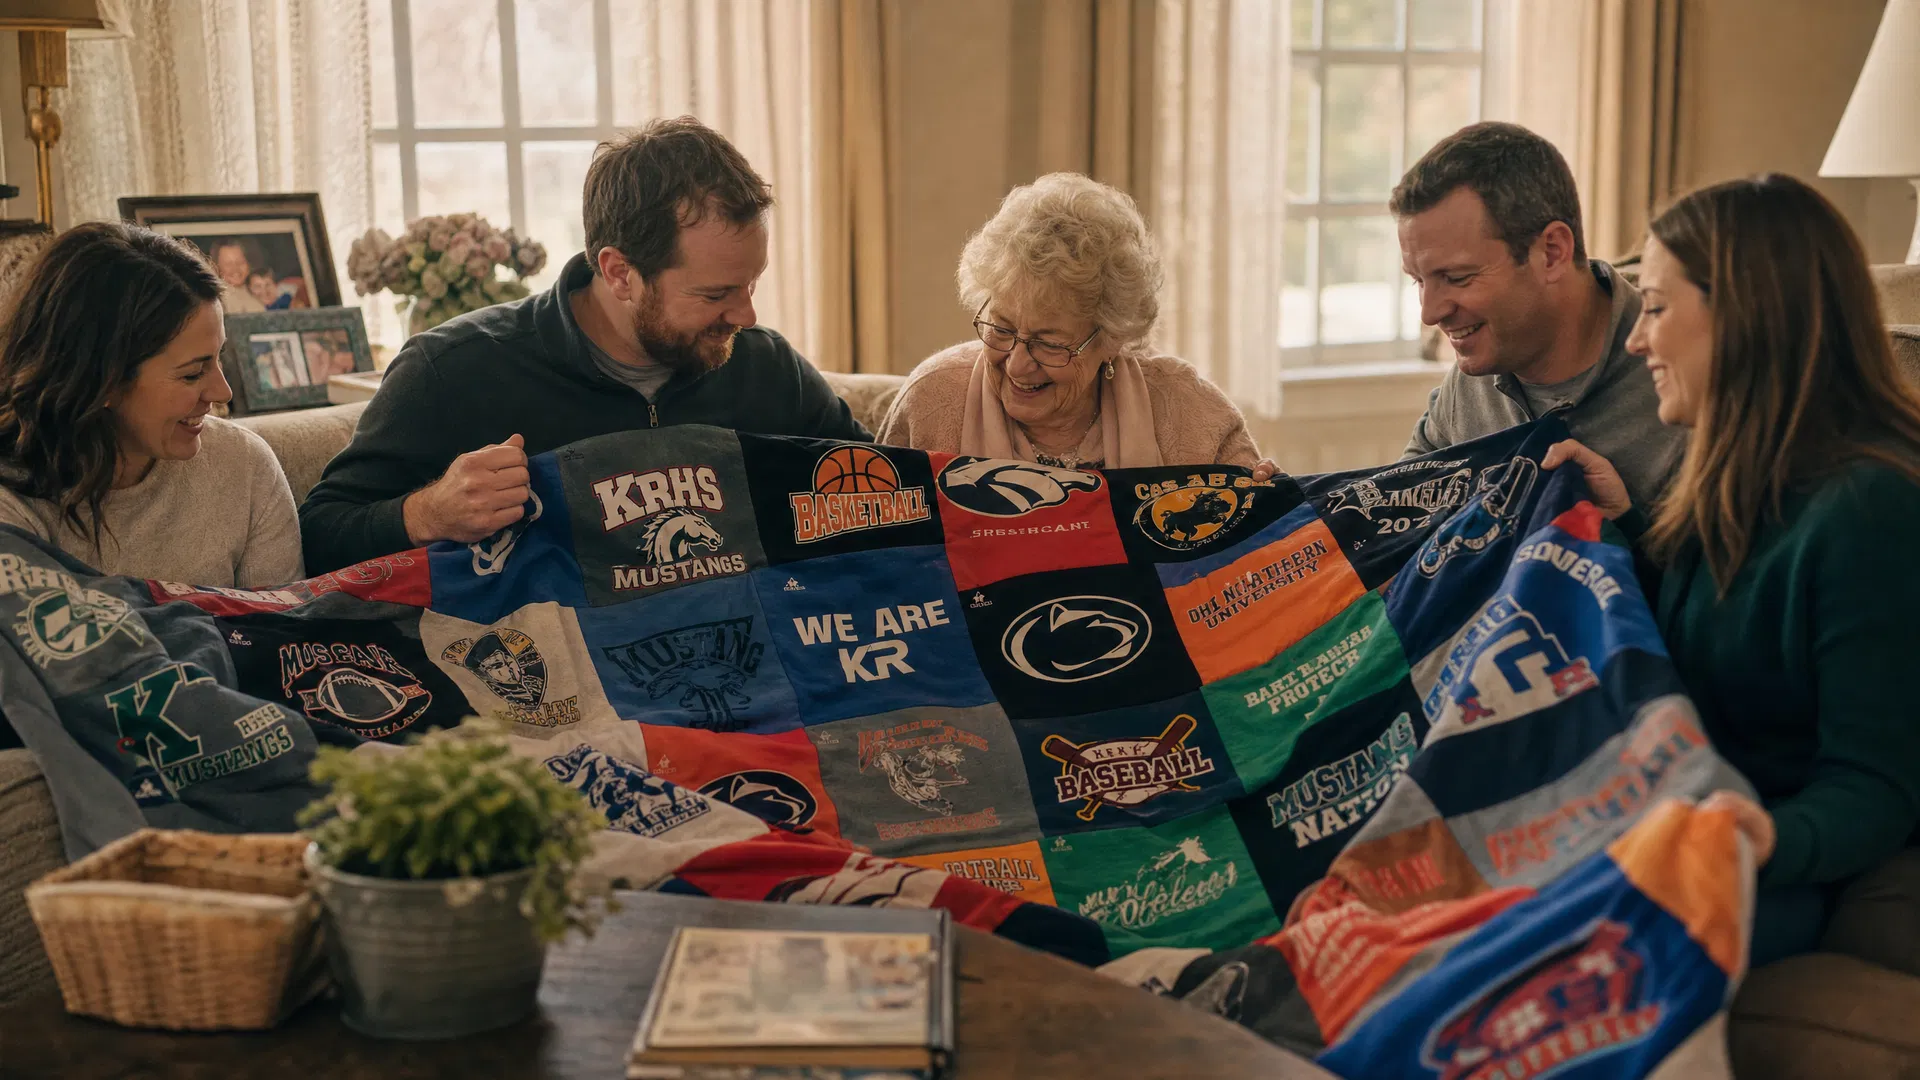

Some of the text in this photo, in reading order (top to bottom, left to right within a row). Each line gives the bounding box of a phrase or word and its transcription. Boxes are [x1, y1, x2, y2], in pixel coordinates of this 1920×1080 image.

[591, 465, 724, 531] KRHS
[789, 486, 931, 544] BASKETBALL
[611, 553, 747, 591] MUSTANGS
[1204, 559, 1319, 630] UNIVERSITY
[602, 615, 765, 688] MUSTANG
[793, 599, 950, 646] WE ARE
[838, 639, 916, 683] KR
[163, 724, 295, 791] MUSTANGS
[1054, 746, 1215, 803] BASEBALL
[1266, 712, 1418, 828] MUSTANG
